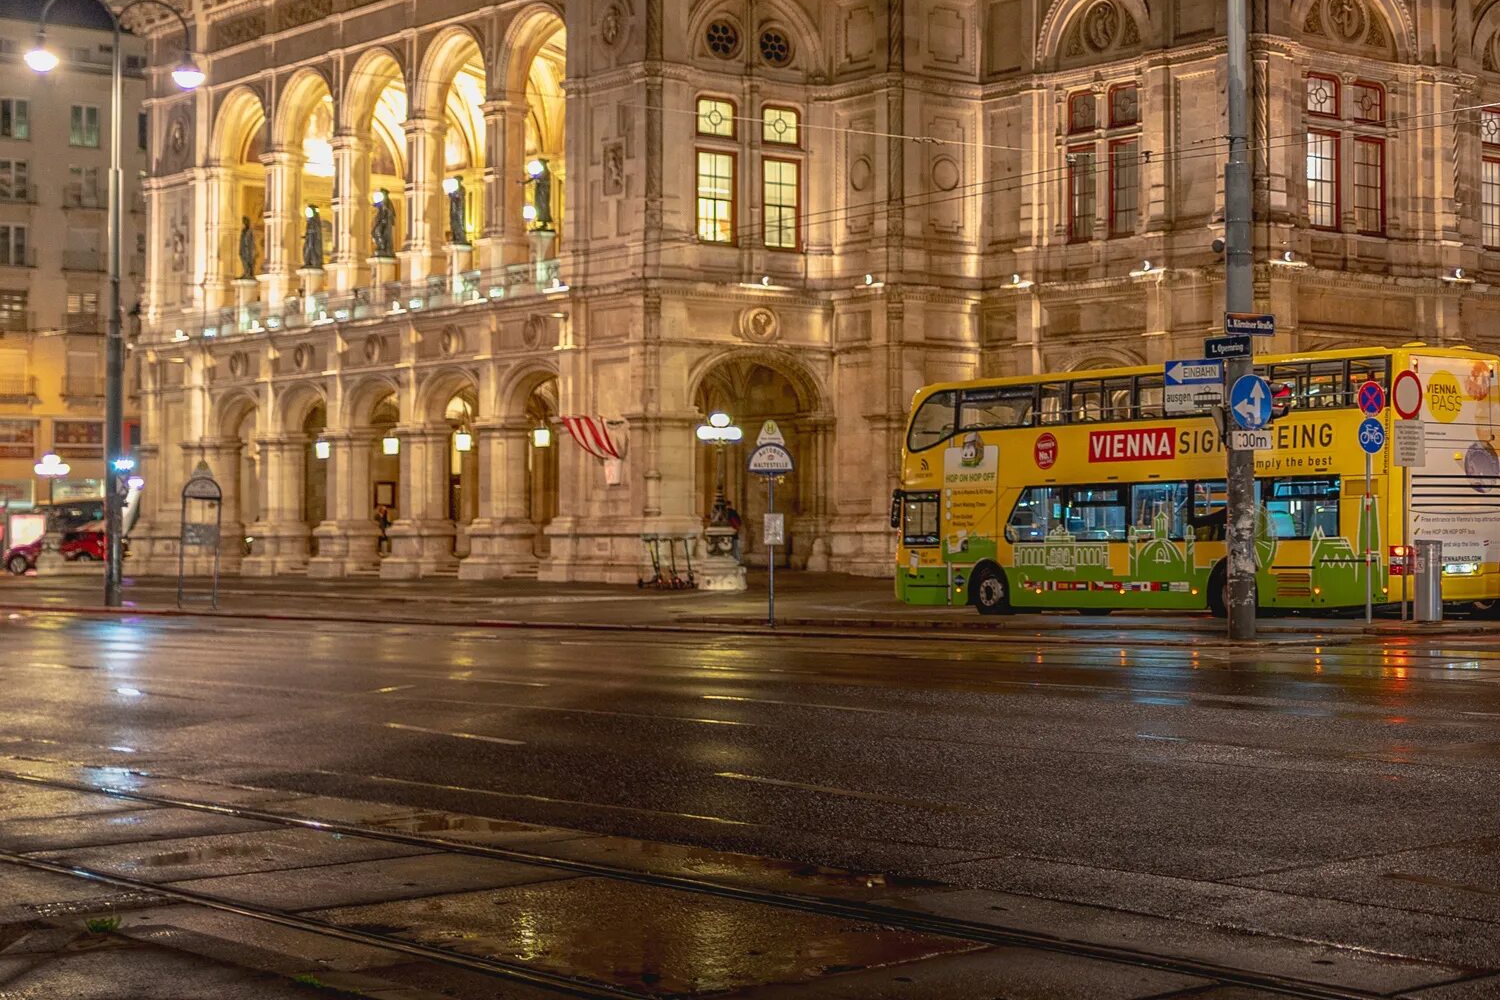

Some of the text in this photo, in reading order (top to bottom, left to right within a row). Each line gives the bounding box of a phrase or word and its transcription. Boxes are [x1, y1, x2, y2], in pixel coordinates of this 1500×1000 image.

[1183, 365, 1217, 378] EINBAHN
[1426, 383, 1457, 394] VIENNA
[1166, 393, 1192, 405] ausgen.
[1431, 394, 1463, 412] PASS
[1092, 431, 1172, 458] VIENNA
[1286, 456, 1303, 468] the
[1308, 455, 1333, 466] best
[946, 472, 995, 483] HOP ON HOP OFF
